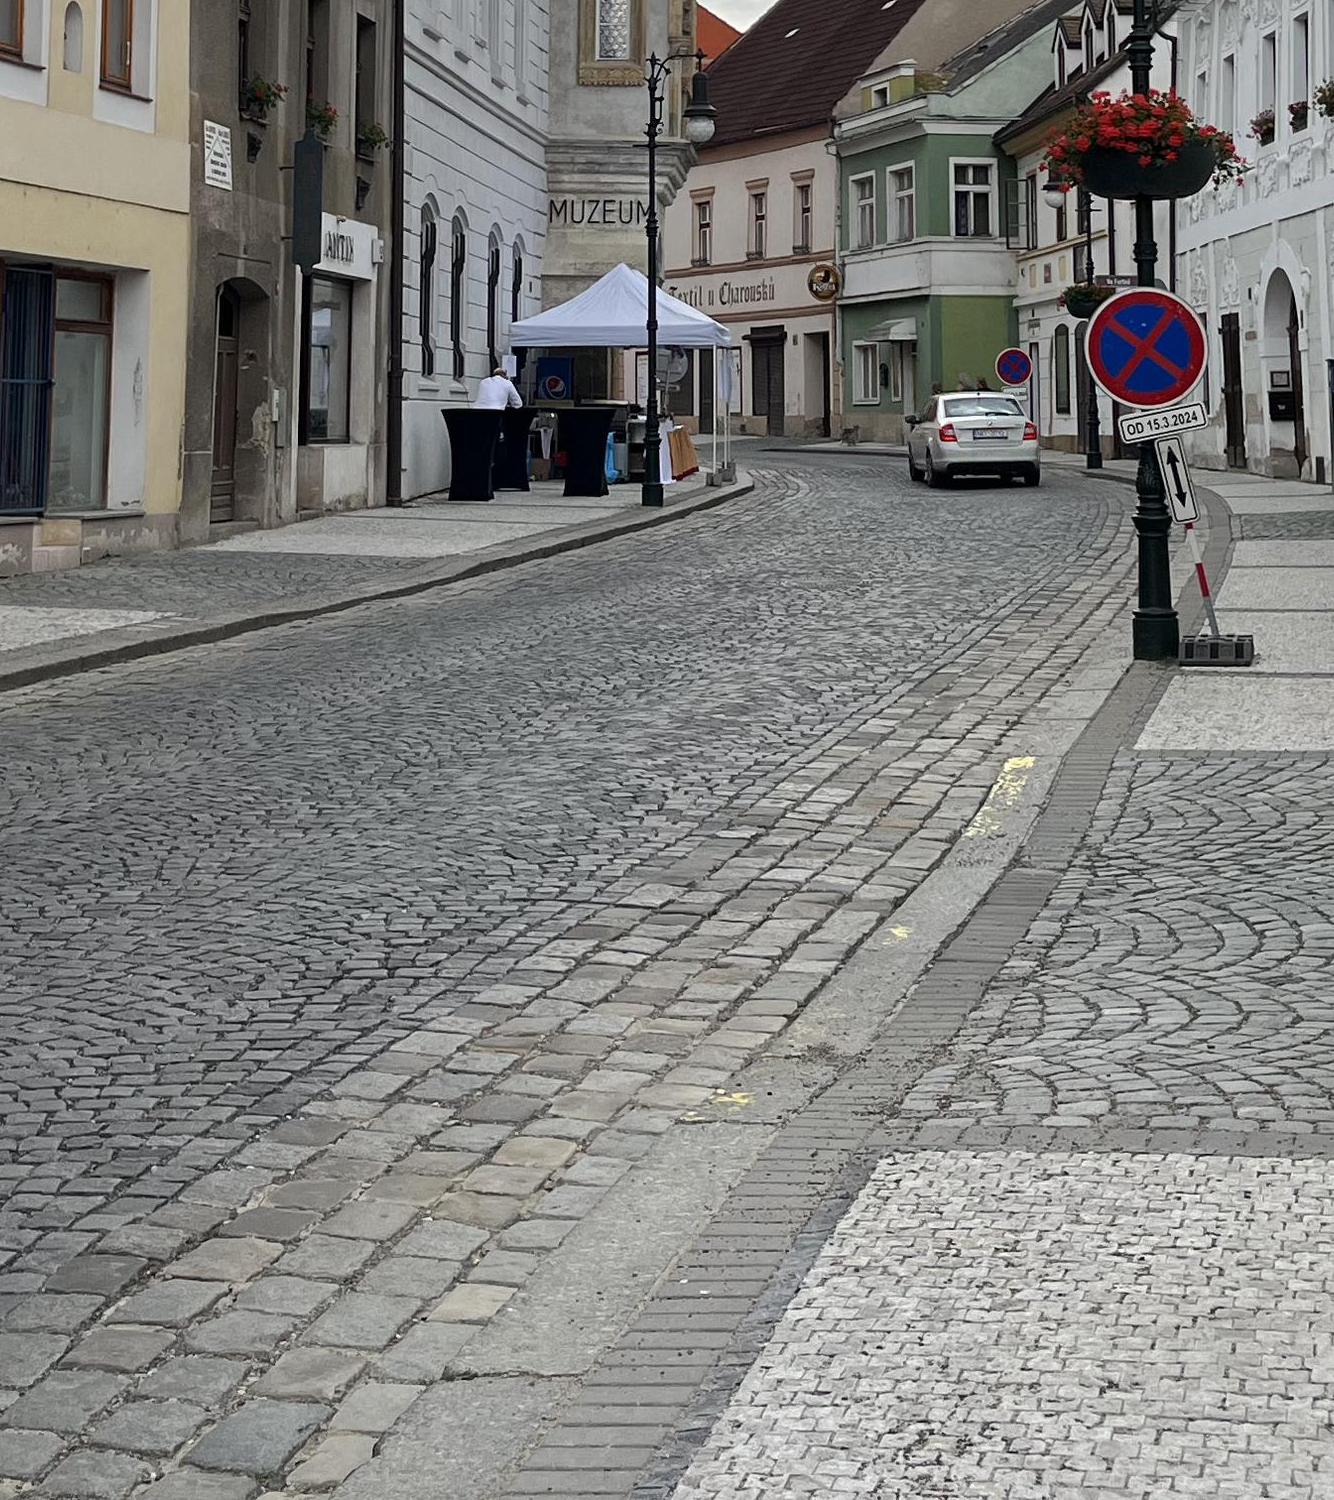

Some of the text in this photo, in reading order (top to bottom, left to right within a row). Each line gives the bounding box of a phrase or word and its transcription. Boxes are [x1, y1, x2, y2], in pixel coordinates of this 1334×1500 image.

[549, 199, 652, 224] MUZEUM
[708, 289, 714, 306] u
[1127, 410, 1198, 435] OD 15.3.2024
